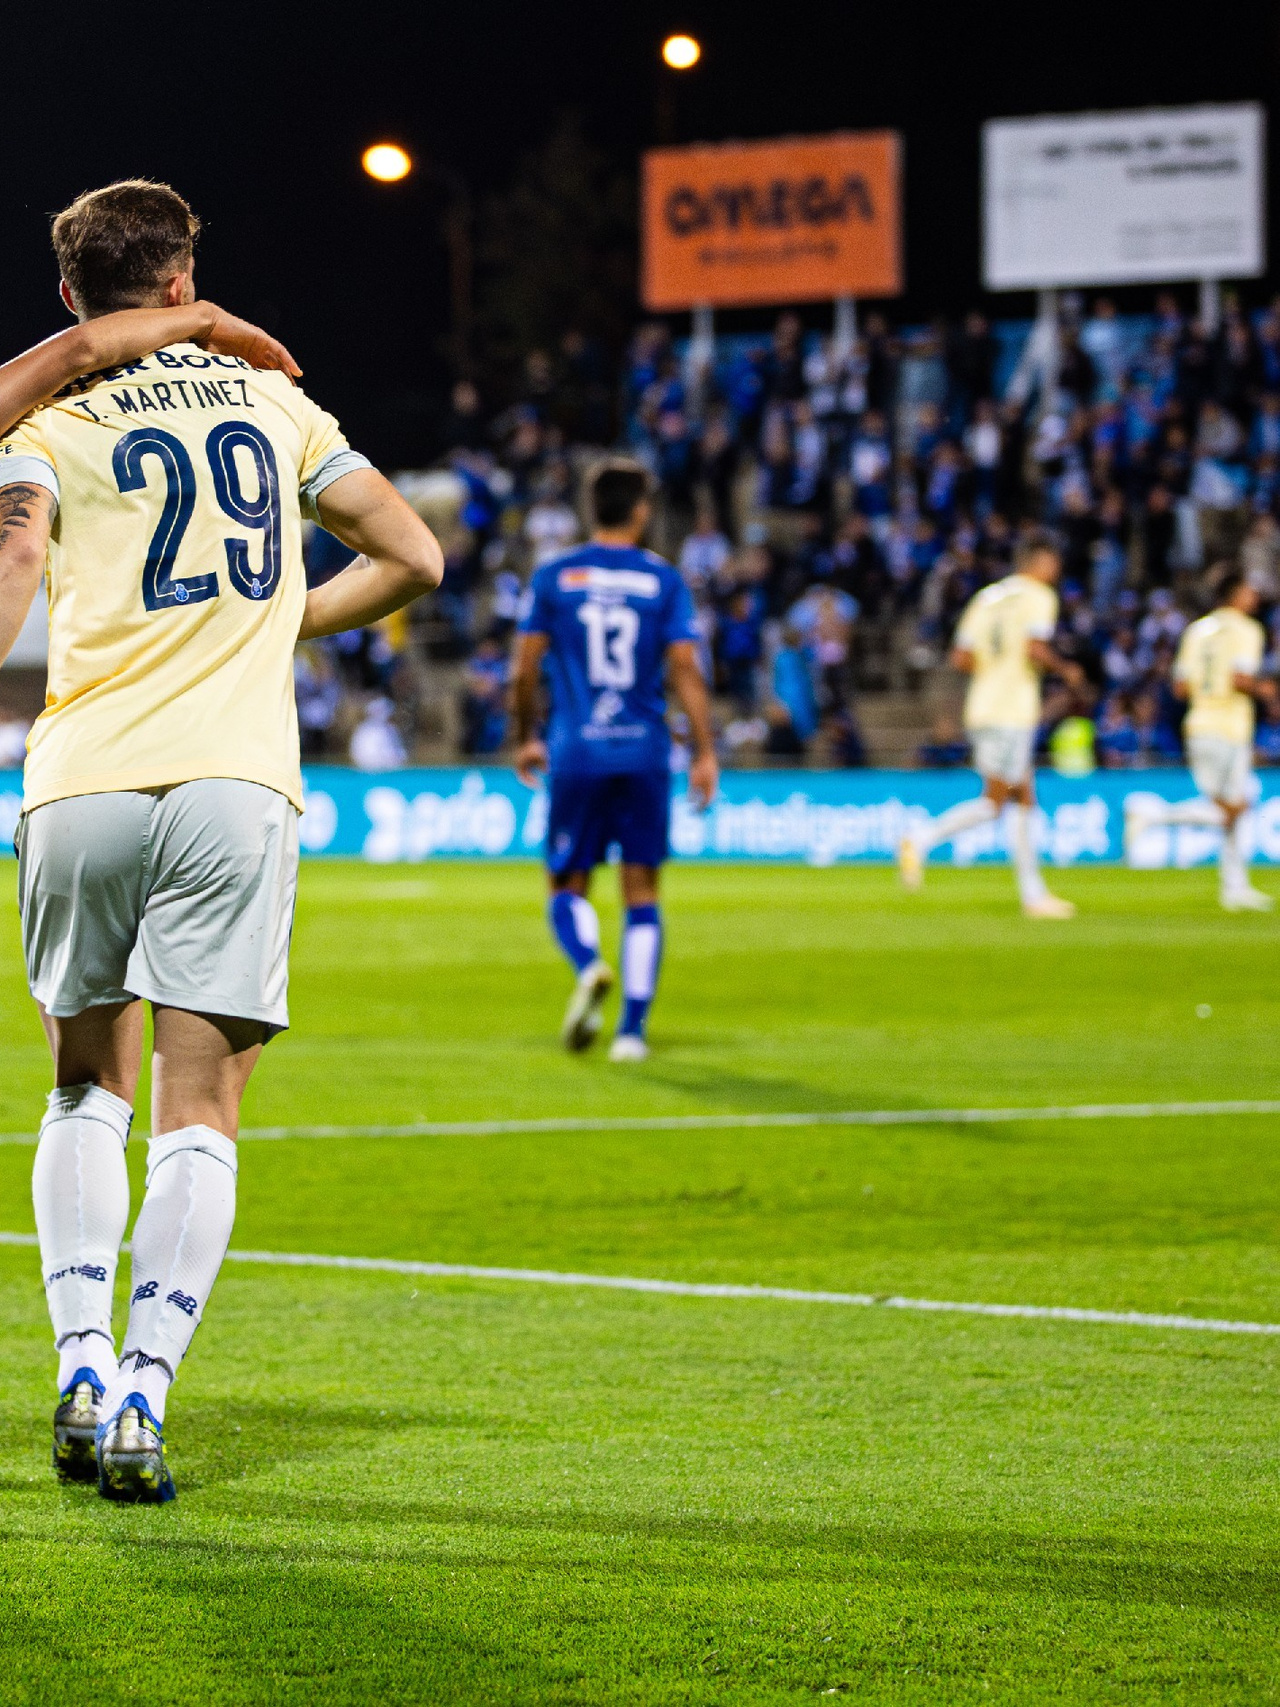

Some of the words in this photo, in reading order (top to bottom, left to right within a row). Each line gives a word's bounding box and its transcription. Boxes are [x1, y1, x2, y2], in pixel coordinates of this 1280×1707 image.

[73, 399, 109, 422] T.
[110, 378, 255, 415] MARTINEZ
[111, 420, 282, 612] 29
[577, 602, 640, 692] 13
